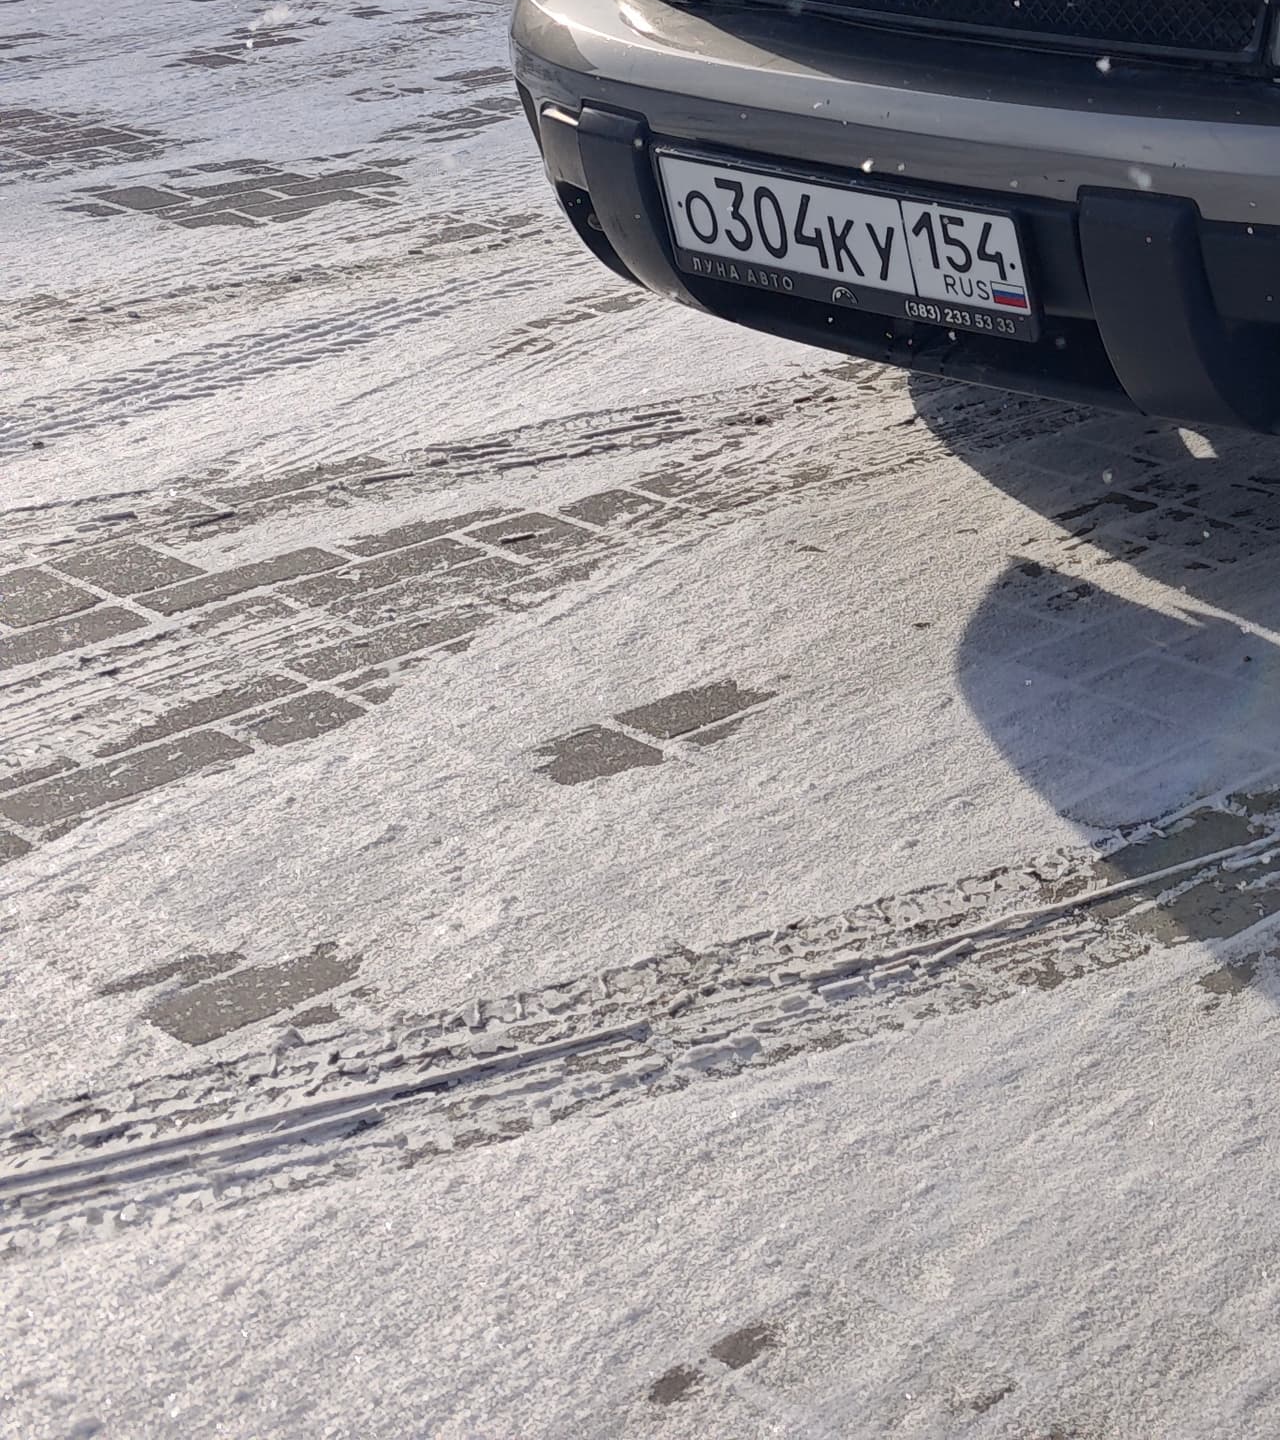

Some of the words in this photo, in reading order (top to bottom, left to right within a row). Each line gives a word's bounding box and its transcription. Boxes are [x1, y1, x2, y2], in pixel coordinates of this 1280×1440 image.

[912, 210, 1007, 281] 154
[692, 257, 739, 280] ЛУНА
[747, 269, 793, 291] АВТО
[944, 274, 990, 301] RUS
[905, 300, 941, 322] (383)
[944, 308, 971, 326] 233
[975, 313, 993, 329] 53
[997, 318, 1015, 334] 33
